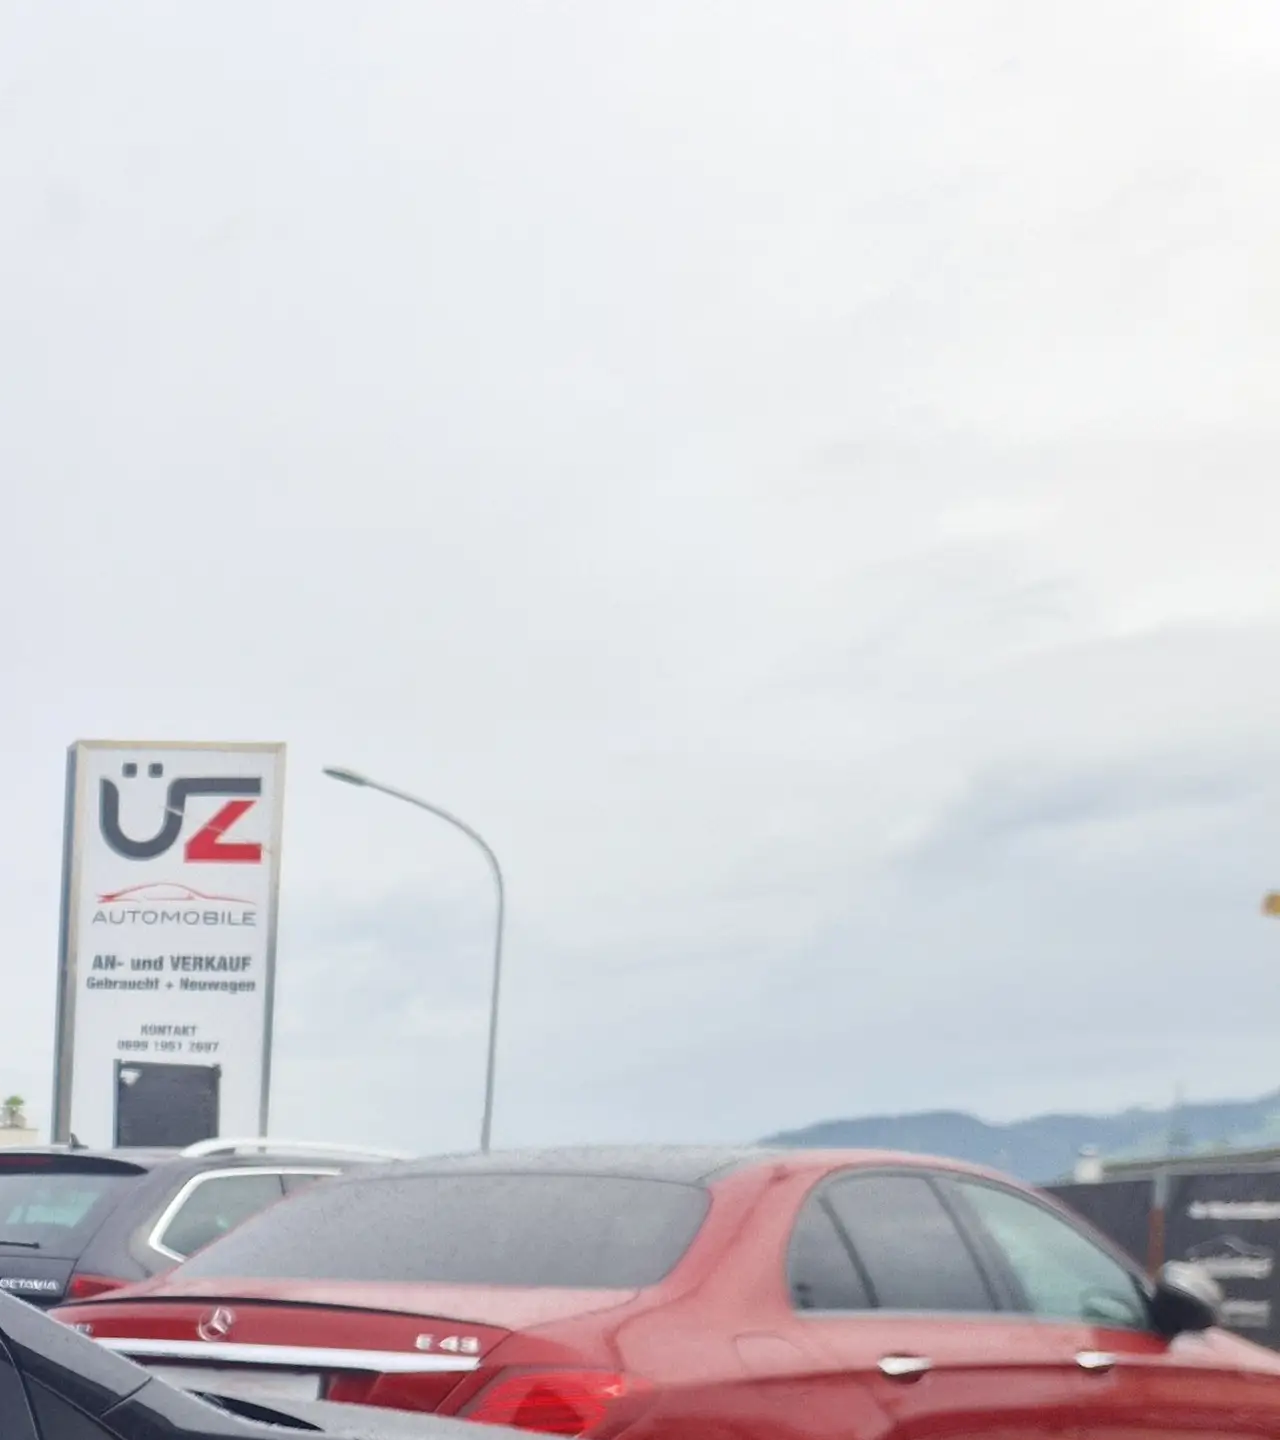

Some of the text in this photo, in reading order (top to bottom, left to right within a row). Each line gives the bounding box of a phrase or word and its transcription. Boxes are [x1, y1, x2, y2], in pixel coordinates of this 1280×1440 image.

[92, 909, 257, 927] AUTOMOBILE
[92, 954, 252, 973] AN- und VERKAUF
[86, 976, 160, 991] Gebraucht
[180, 976, 256, 995] Neuwagen
[140, 1024, 197, 1036] KONTAKT
[0, 1278, 58, 1291] OCTAVIA
[415, 1332, 434, 1351] E
